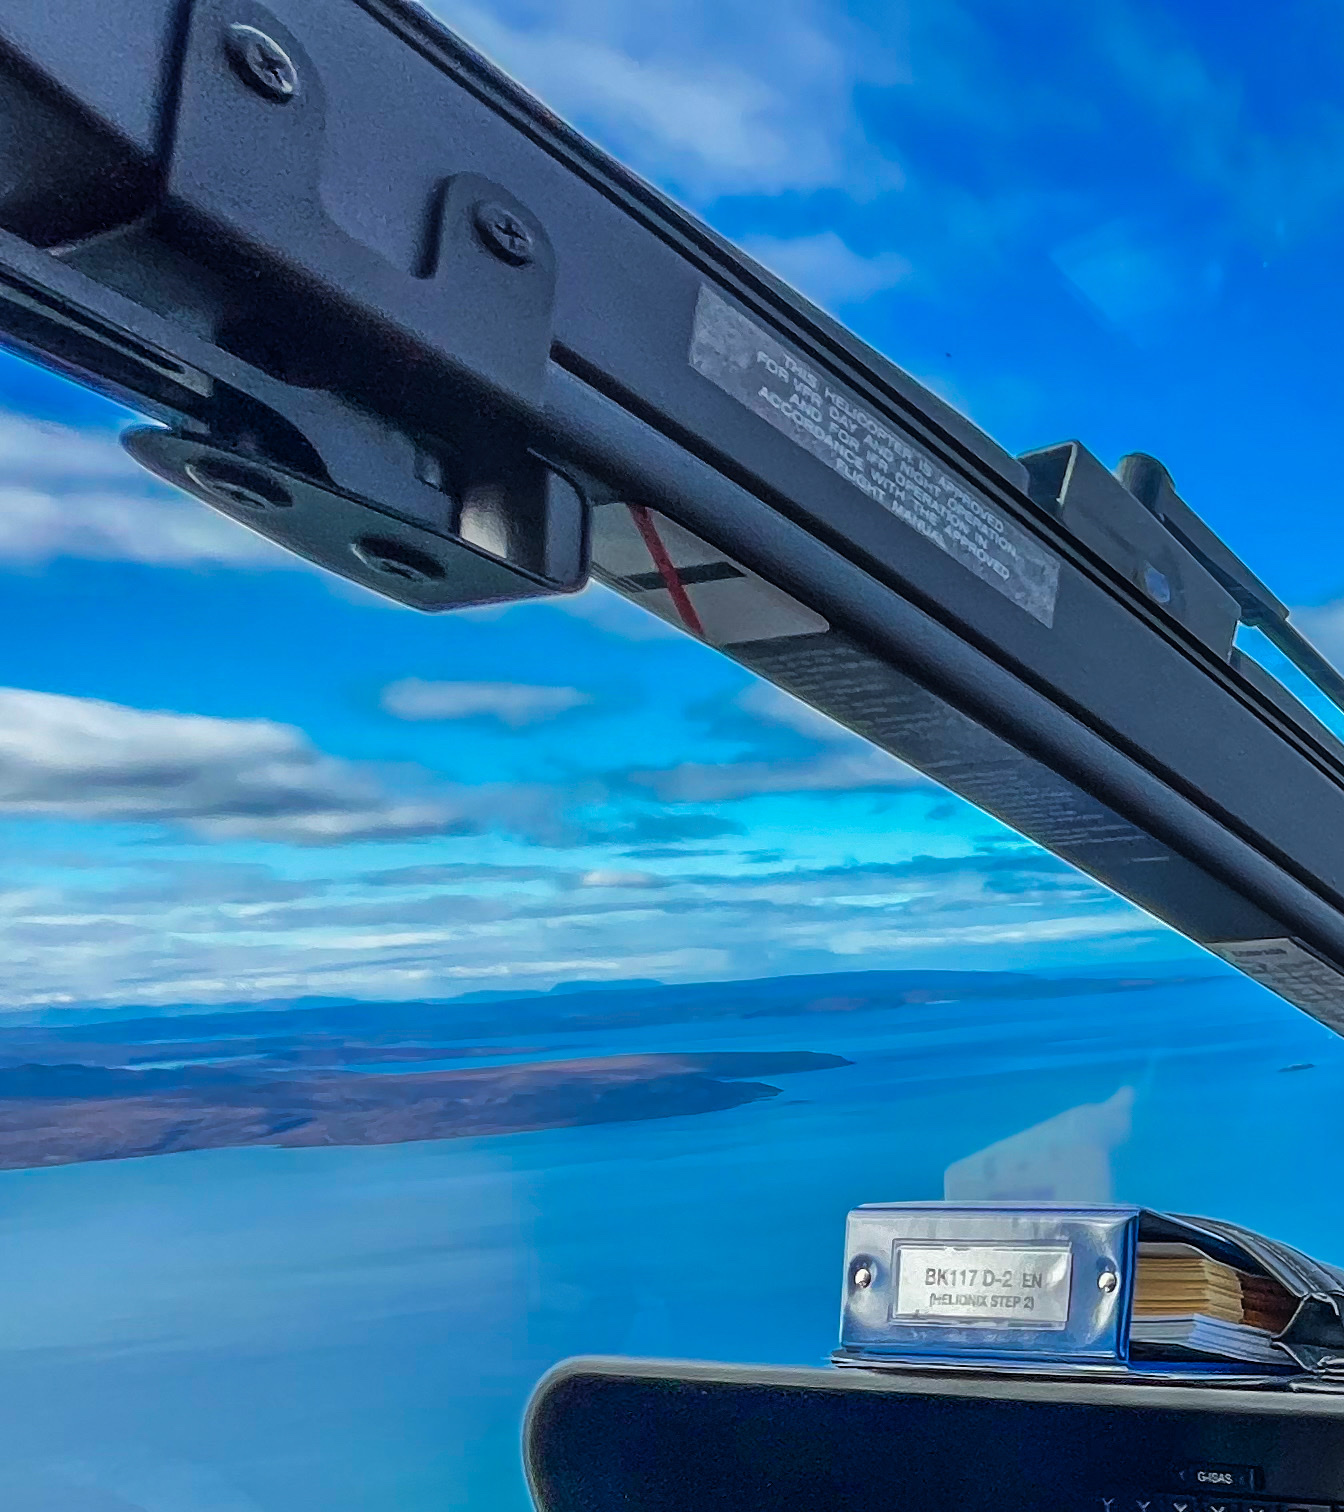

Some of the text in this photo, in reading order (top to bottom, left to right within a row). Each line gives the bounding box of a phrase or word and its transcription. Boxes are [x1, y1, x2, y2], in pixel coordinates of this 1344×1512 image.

[757, 351, 789, 383] FOR
[829, 406, 858, 432] DAY
[863, 434, 894, 462] AND
[900, 461, 941, 497] NIGHT
[790, 393, 823, 422] AND
[829, 422, 860, 452] FOR
[895, 472, 971, 534] OPERATION
[757, 386, 1010, 581] ACCORDANCE WITH THE APPROVED
[925, 1268, 1042, 1288] BK117 D-2 EN
[989, 1295, 1021, 1308] STEP
[1023, 1296, 1035, 1310] 2)
[1197, 1470, 1233, 1485] G-ISAS
